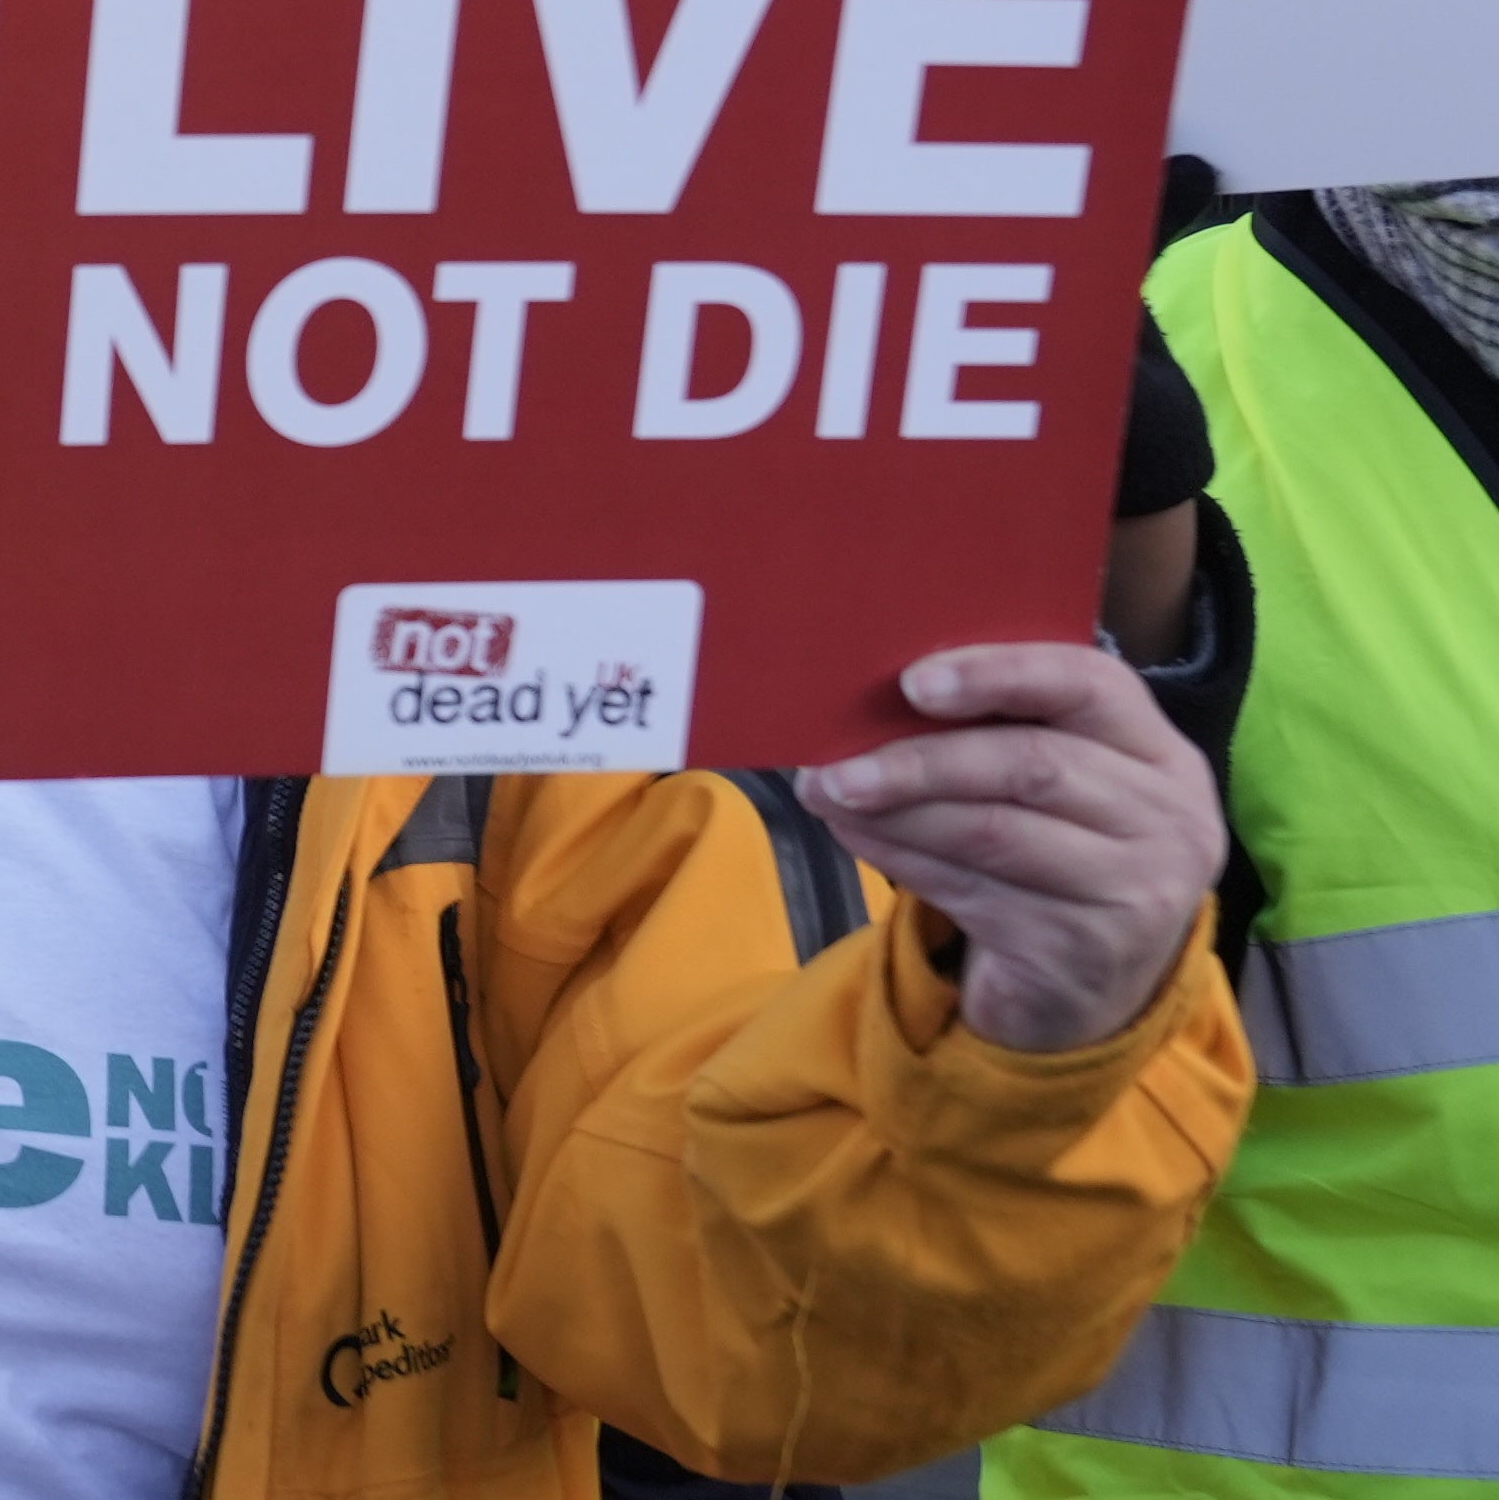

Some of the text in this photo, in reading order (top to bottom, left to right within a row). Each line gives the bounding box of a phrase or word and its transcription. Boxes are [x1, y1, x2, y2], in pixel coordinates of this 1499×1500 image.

[58, 256, 1055, 448] NOT DIE
[387, 617, 495, 671] not
[390, 668, 652, 738] dead yet
